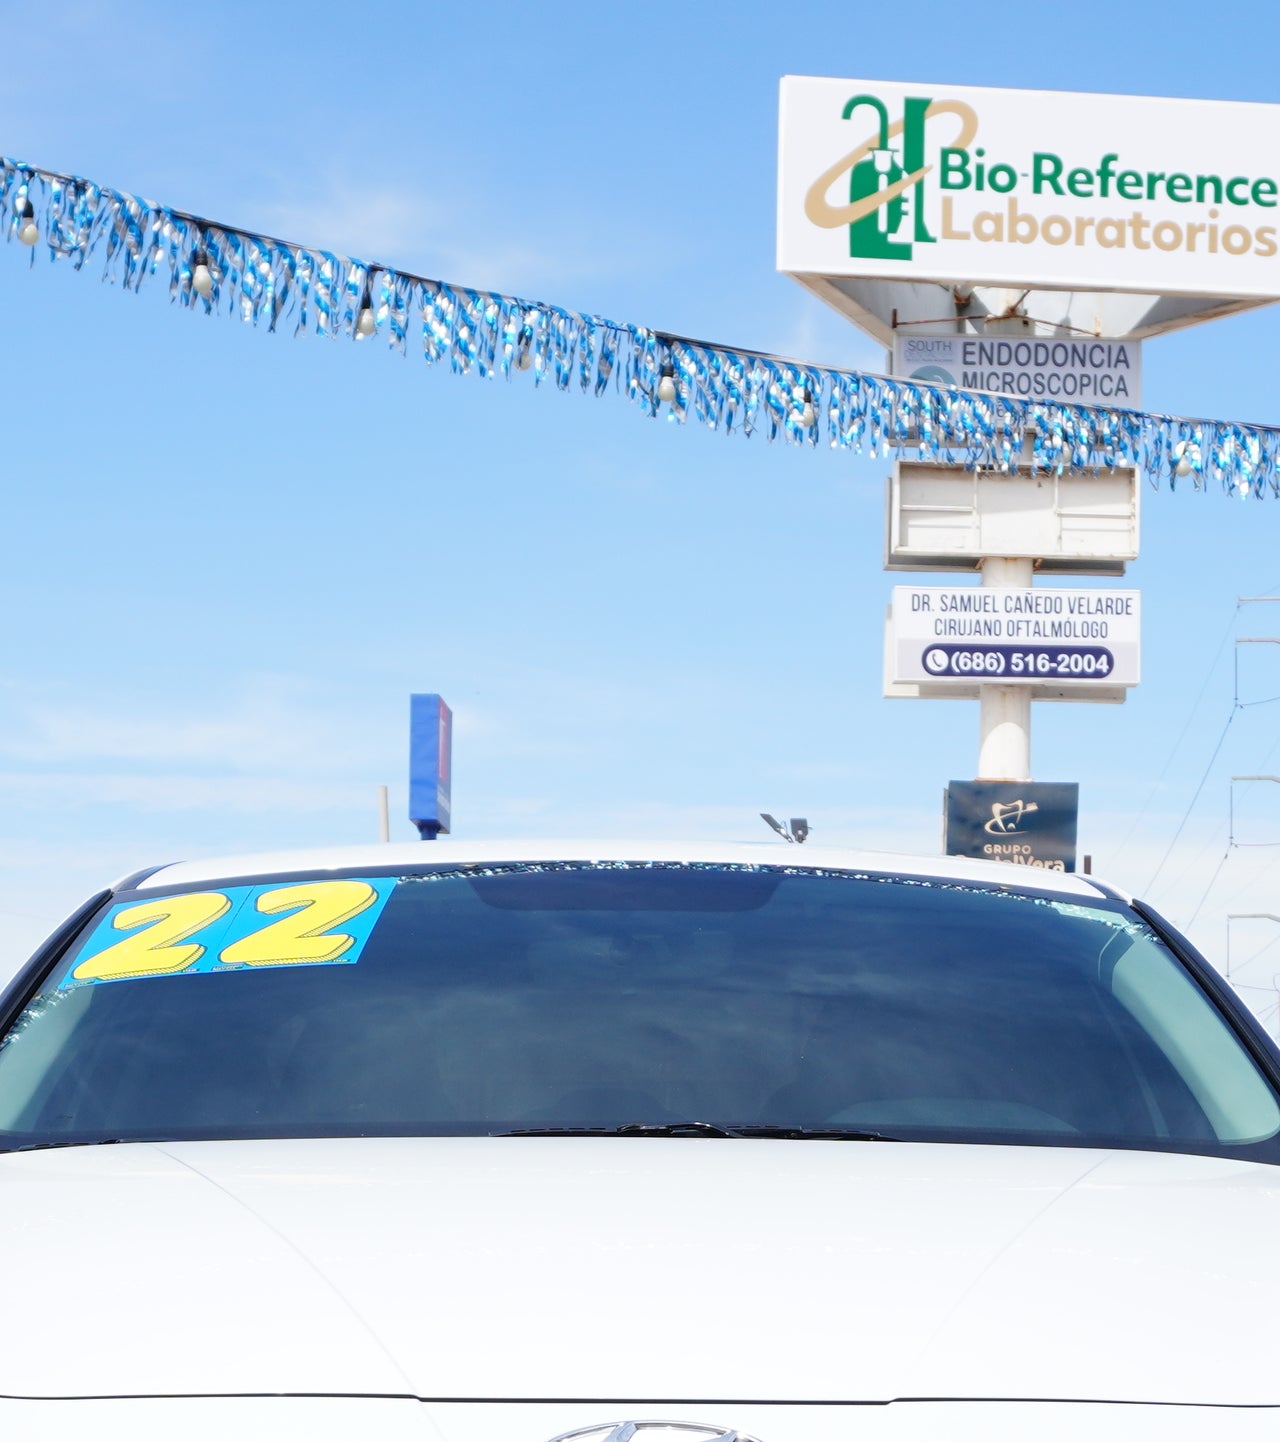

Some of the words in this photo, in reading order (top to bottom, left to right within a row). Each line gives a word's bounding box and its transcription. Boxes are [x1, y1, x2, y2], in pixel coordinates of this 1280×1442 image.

[939, 147, 1278, 208] Bio-Reference
[941, 196, 1278, 258] Laboratorios
[907, 340, 952, 352] SOUTH
[962, 341, 1130, 369] ENDODONCIA
[962, 371, 1129, 397] MICROSCOPICA
[911, 594, 934, 612] DR.
[940, 594, 998, 614] SAMUEL
[1004, 593, 1063, 615] CAÑEDO
[1068, 596, 1133, 616] VELARDE
[934, 618, 1002, 637] CIRUJANO
[1006, 617, 1108, 639] OFTALMÓLOGO
[951, 651, 1005, 673] (686)
[1011, 653, 1109, 673] 516-2004
[983, 844, 1032, 855] GRUPO
